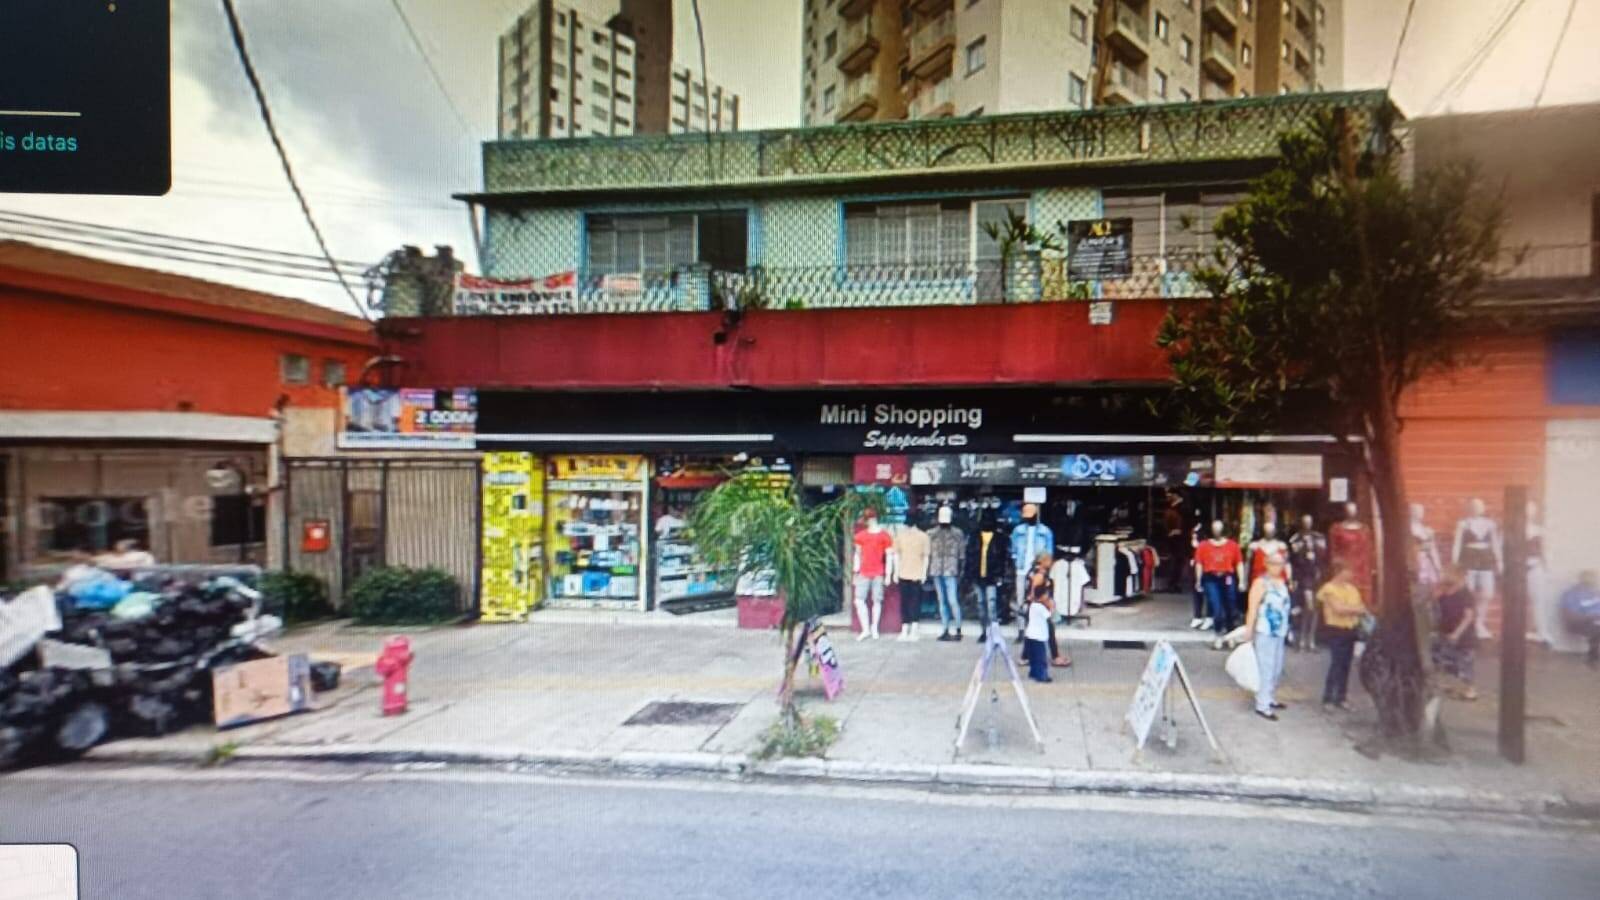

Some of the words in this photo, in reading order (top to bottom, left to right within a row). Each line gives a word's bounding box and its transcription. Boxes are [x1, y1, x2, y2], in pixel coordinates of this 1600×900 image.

[21, 132, 78, 152] datas
[820, 404, 867, 424] Mini
[874, 403, 983, 429] Shopping
